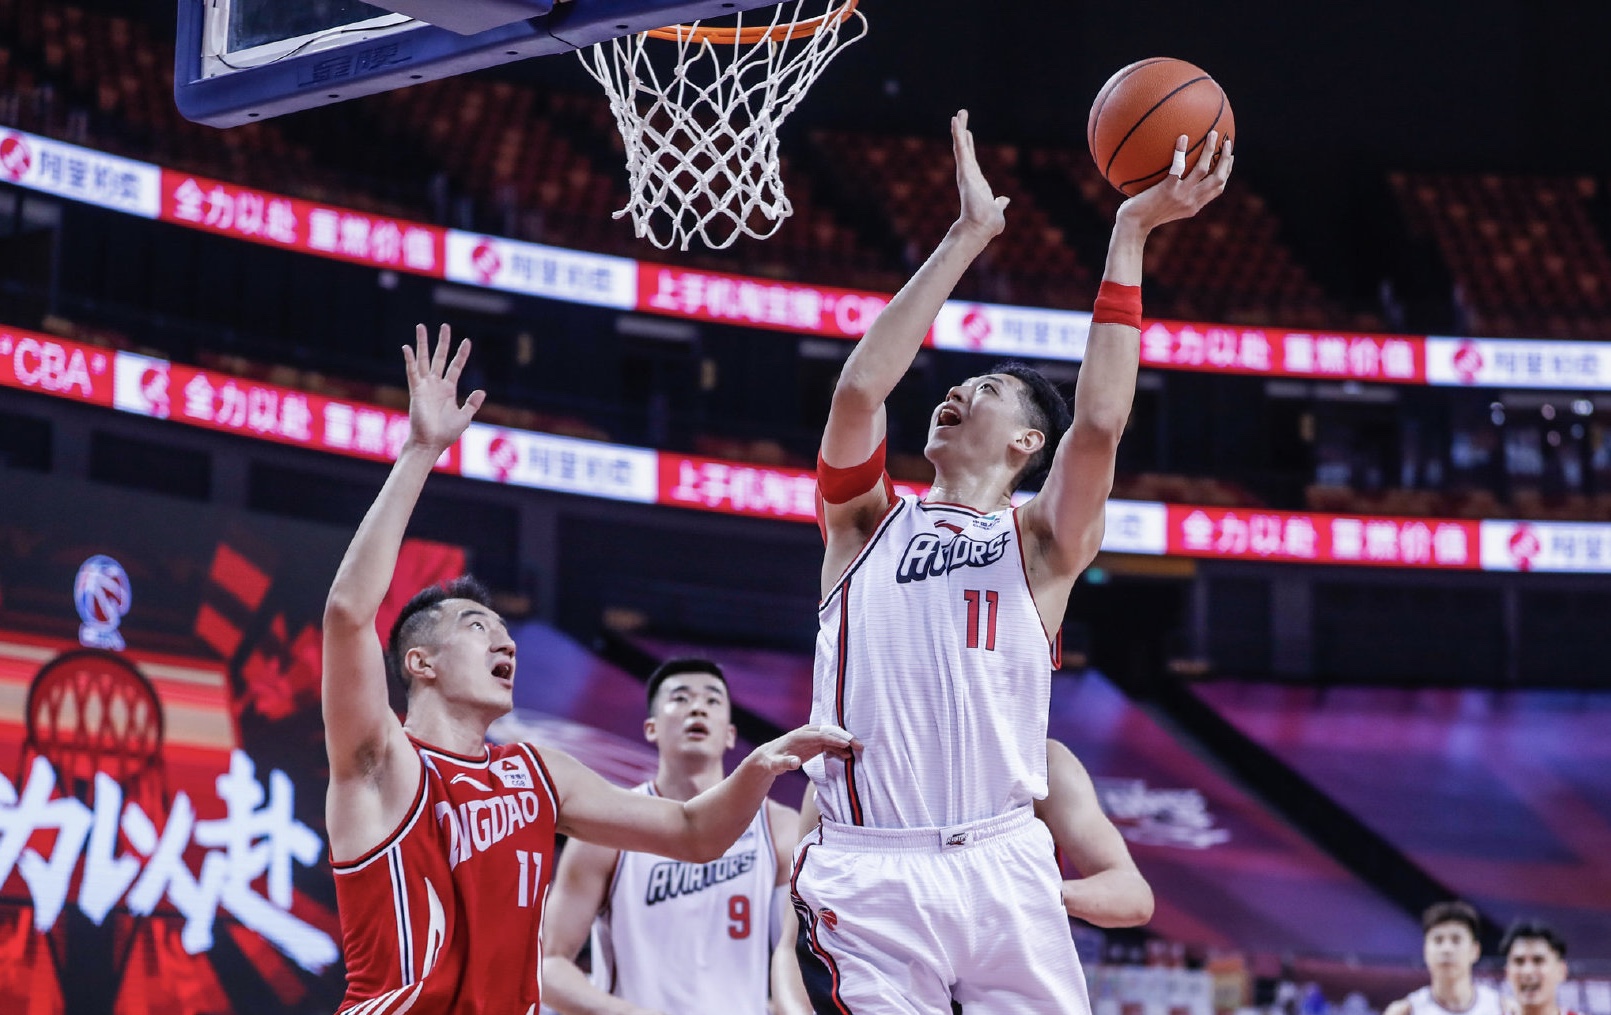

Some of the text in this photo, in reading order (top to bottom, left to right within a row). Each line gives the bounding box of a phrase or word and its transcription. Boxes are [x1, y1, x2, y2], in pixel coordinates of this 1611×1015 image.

[964, 589, 998, 651] 11
[0, 748, 339, 976] 力以赴
[516, 849, 542, 908] 11
[645, 849, 757, 906] AVIATORS
[727, 894, 751, 940] 9
